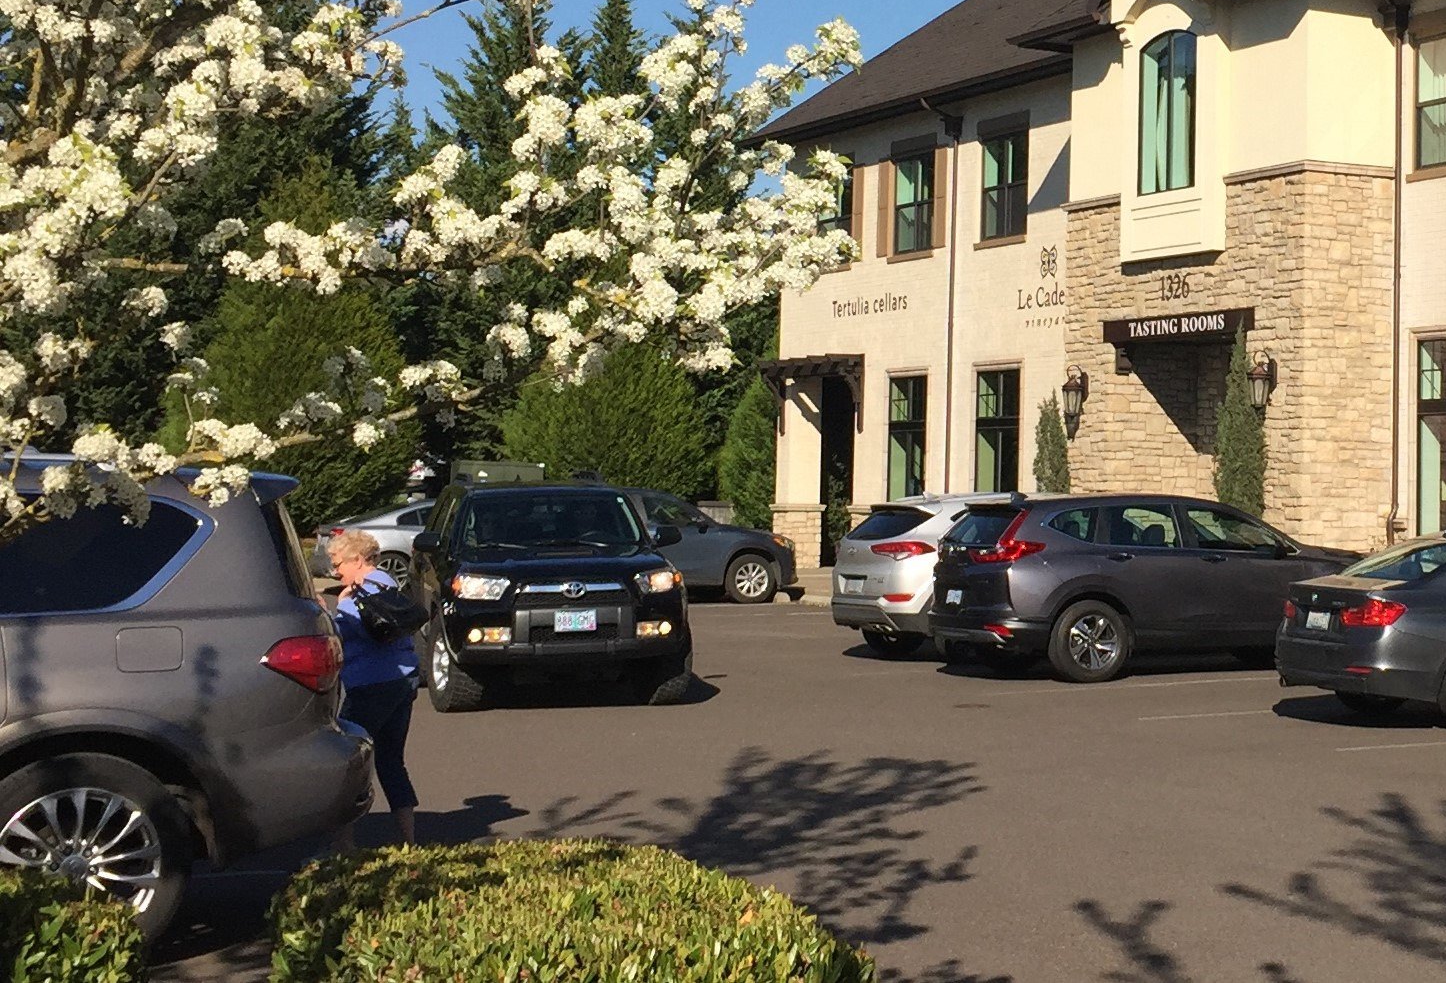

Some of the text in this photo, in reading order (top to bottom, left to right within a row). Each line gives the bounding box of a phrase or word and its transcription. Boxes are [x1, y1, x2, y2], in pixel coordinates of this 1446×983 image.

[1017, 289, 1033, 310] Le
[1160, 272, 1190, 302] 1326
[832, 292, 908, 318] Tertulia cellars
[1128, 313, 1226, 338] TASTING ROOMS
